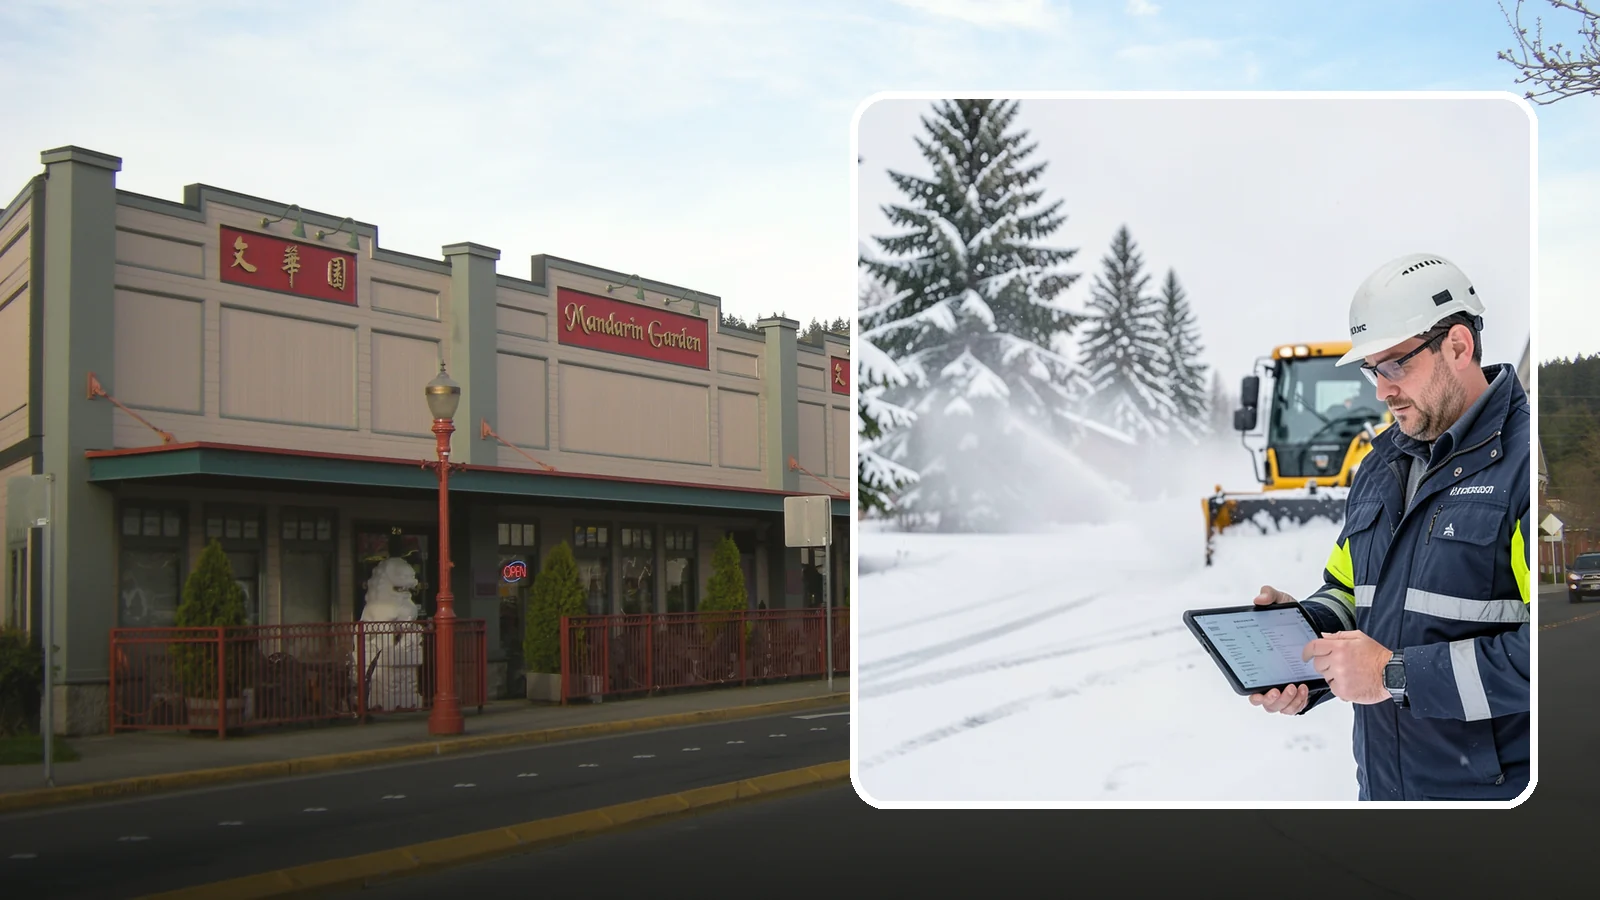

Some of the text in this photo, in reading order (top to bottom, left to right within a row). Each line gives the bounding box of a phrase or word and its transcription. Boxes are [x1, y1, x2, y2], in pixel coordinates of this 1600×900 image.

[231, 235, 346, 291] 文華園
[565, 302, 702, 352] Mandarin Garden
[503, 565, 527, 578] OPEN
